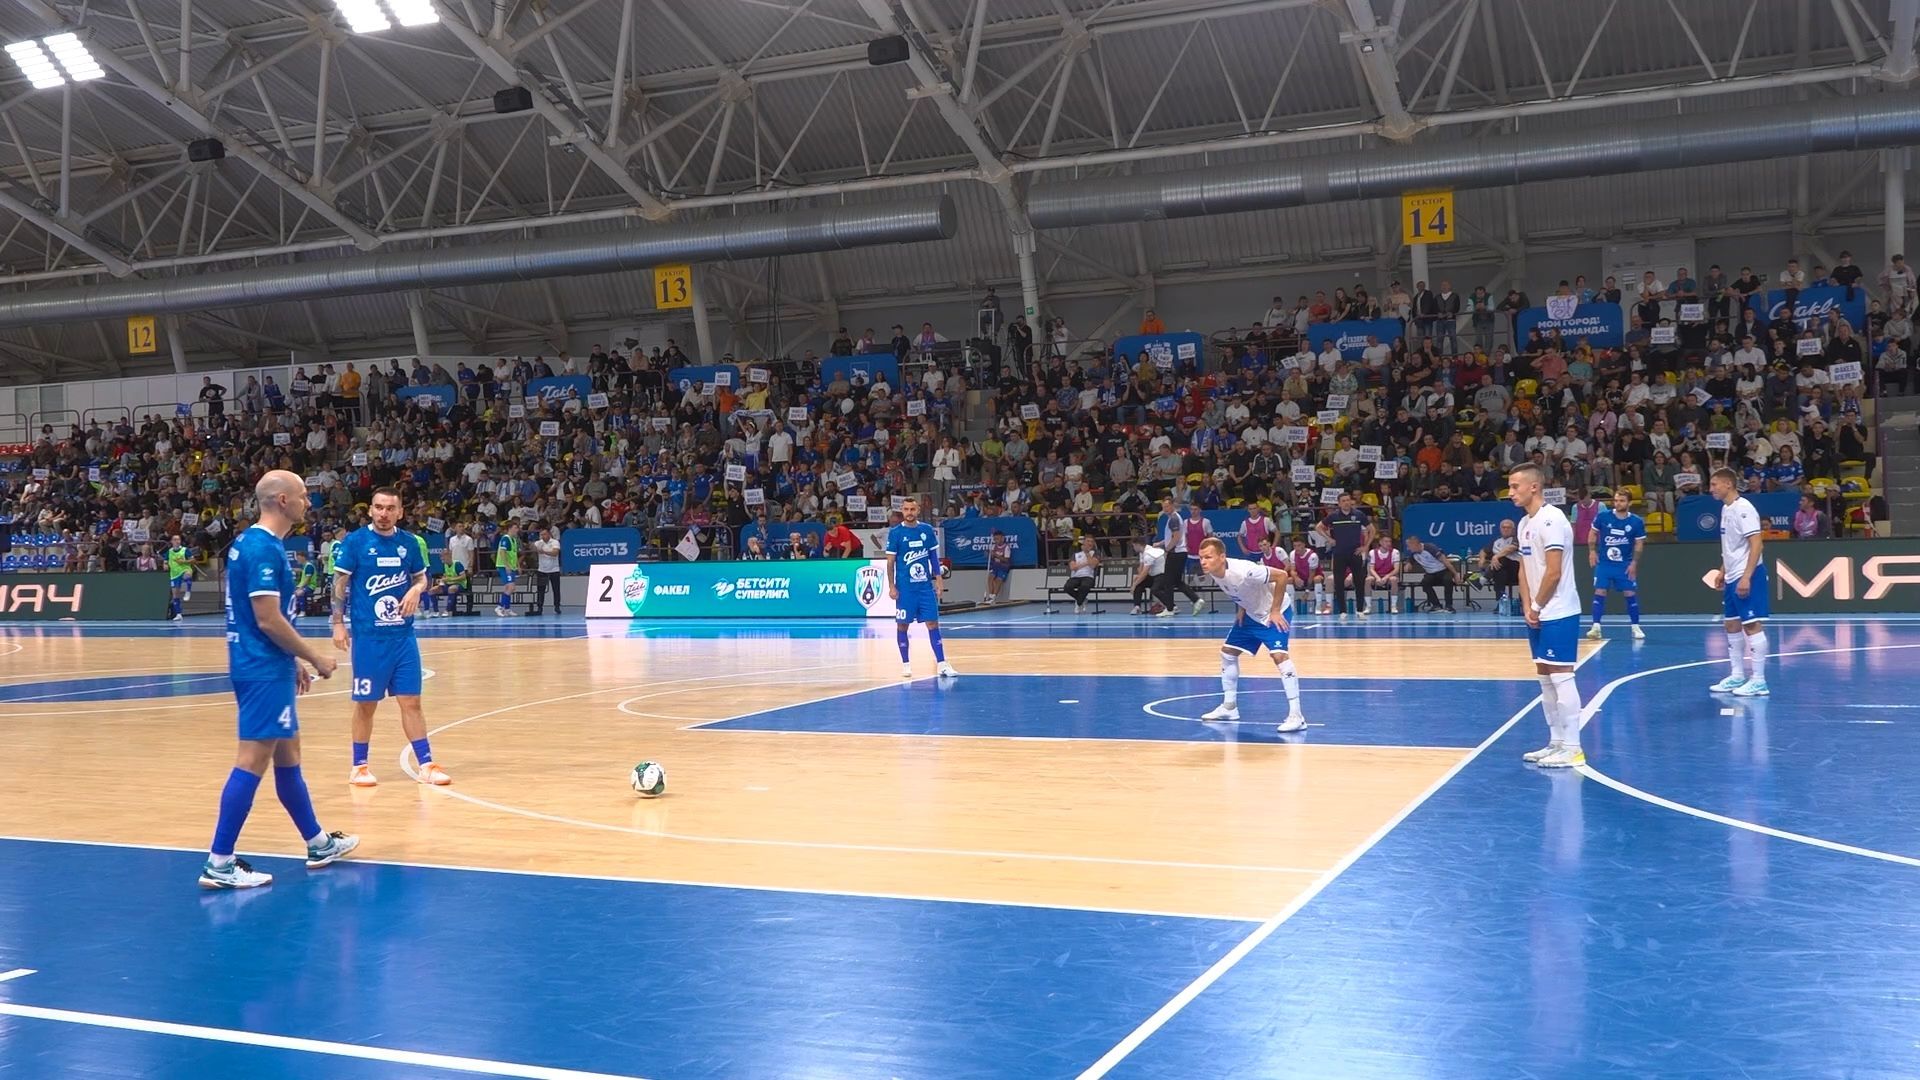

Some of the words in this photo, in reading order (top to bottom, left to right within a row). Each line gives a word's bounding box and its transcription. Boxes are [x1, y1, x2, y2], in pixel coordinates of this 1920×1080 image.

[1409, 206, 1447, 238] 14
[659, 277, 687, 304] 13
[1562, 316, 1600, 326] ГОРОД!
[132, 326, 152, 348] 12
[1560, 326, 1609, 336] ОМАНДА!
[1455, 520, 1496, 536] Utair
[573, 547, 611, 557] СЕКТОР
[611, 542, 629, 556] 13
[598, 575, 613, 602] 2
[653, 584, 690, 595] ФАКЕЛ
[736, 577, 791, 588] БЕТСИТИ
[818, 583, 848, 594] УХТА
[735, 589, 790, 600] СУПЕРЛИГА
[895, 608, 907, 620] 20
[353, 678, 372, 696] 13
[278, 707, 291, 729] 4
